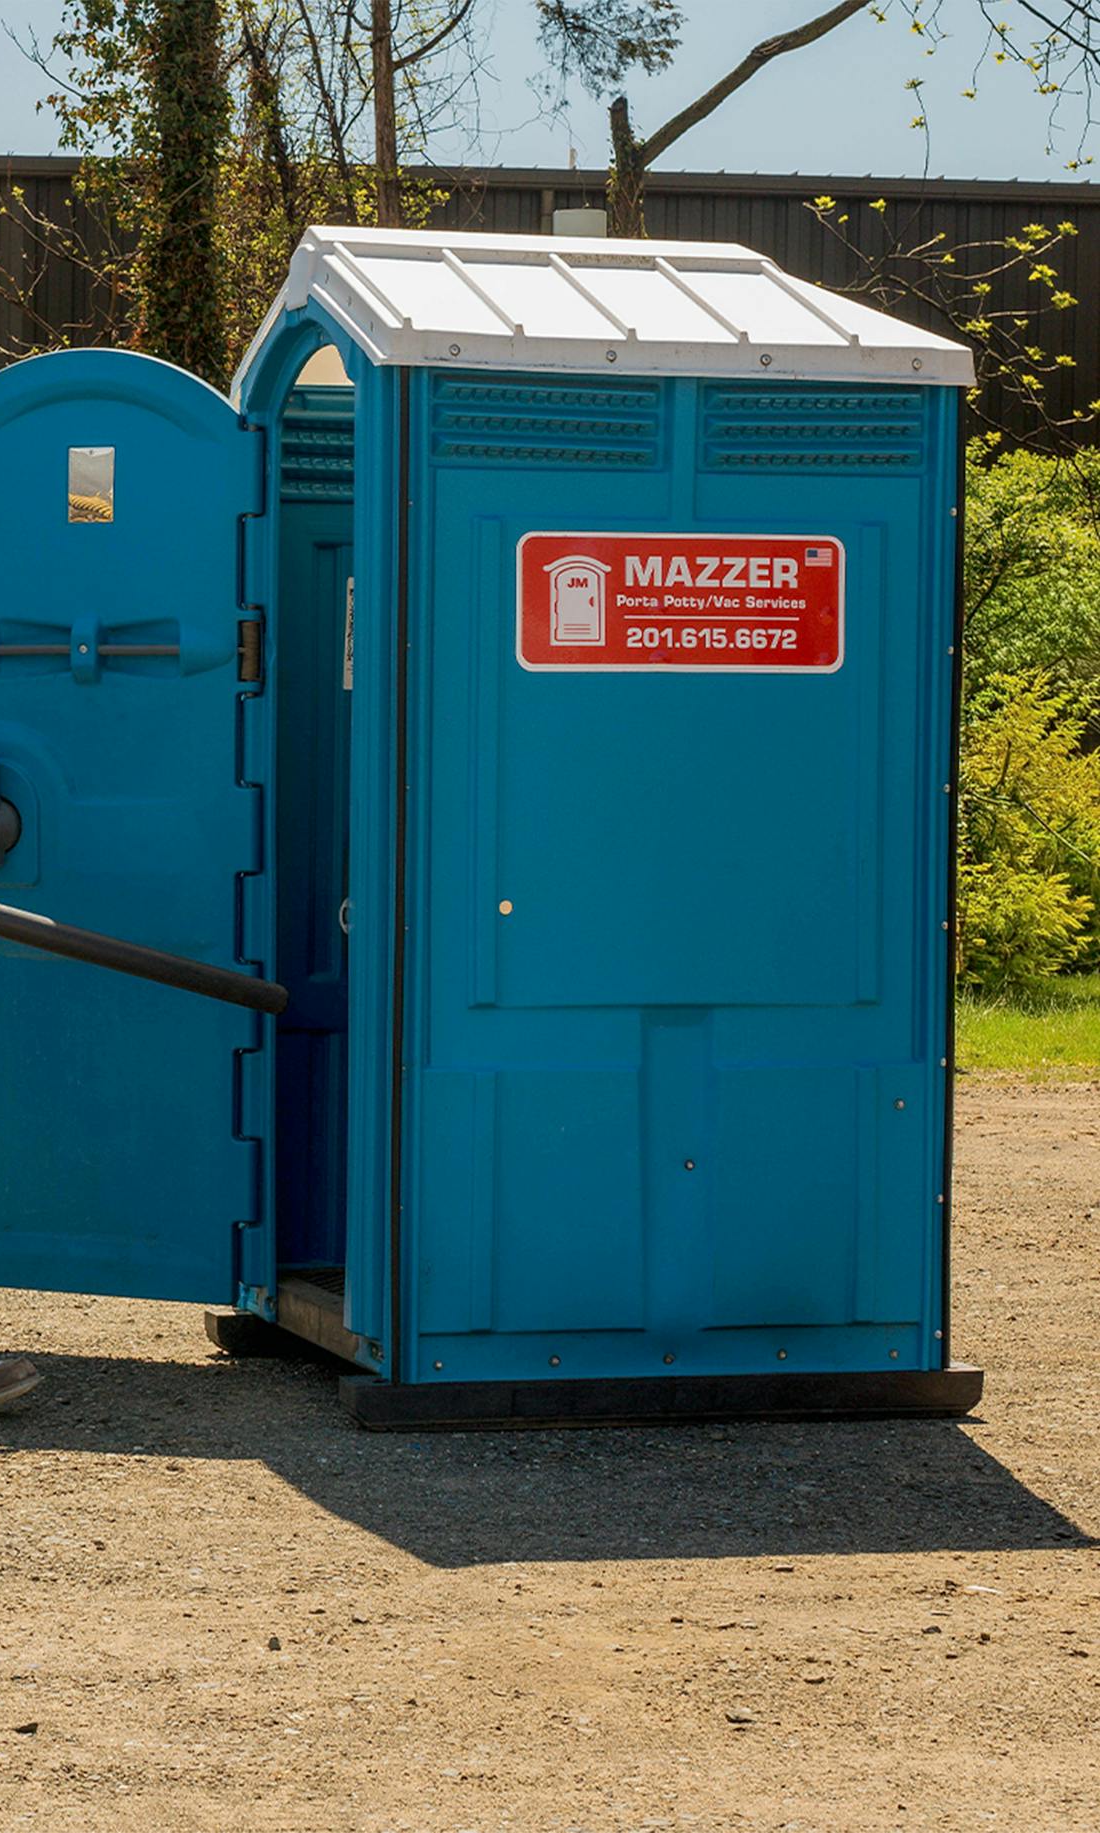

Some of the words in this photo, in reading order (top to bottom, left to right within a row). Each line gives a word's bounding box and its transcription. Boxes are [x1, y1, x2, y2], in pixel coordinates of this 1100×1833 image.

[624, 555, 799, 589] MAZZER
[567, 577, 589, 588] JM
[616, 594, 659, 608] Porta
[663, 594, 741, 610] Potty/Vac
[745, 595, 807, 609] Services
[626, 627, 798, 650] 201.615.6672
